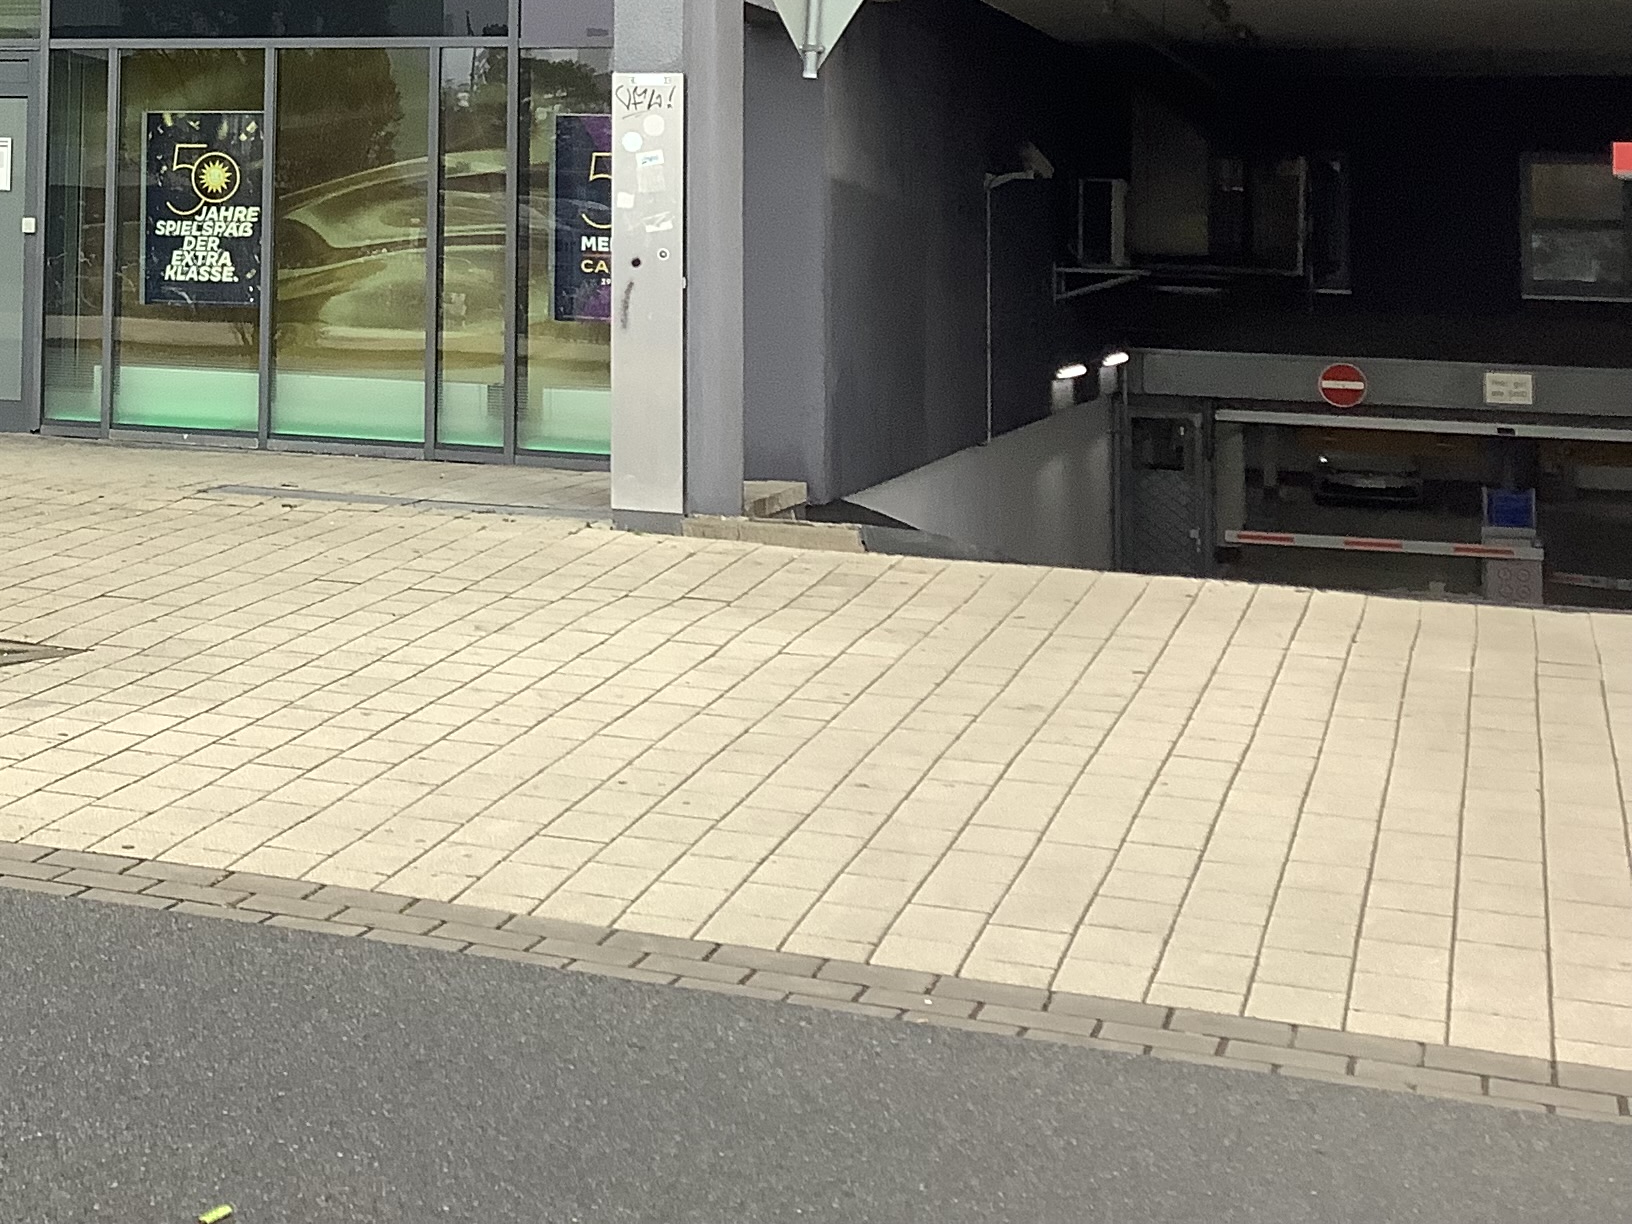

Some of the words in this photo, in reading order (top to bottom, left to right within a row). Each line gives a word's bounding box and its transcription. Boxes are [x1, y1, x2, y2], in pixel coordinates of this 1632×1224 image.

[581, 152, 612, 229] 5
[195, 206, 260, 222] JAHRE
[182, 237, 219, 251] DER
[581, 236, 612, 252] ME
[171, 250, 232, 266] EXTRA
[581, 259, 610, 273] CA
[164, 265, 239, 282] KLASSE.
